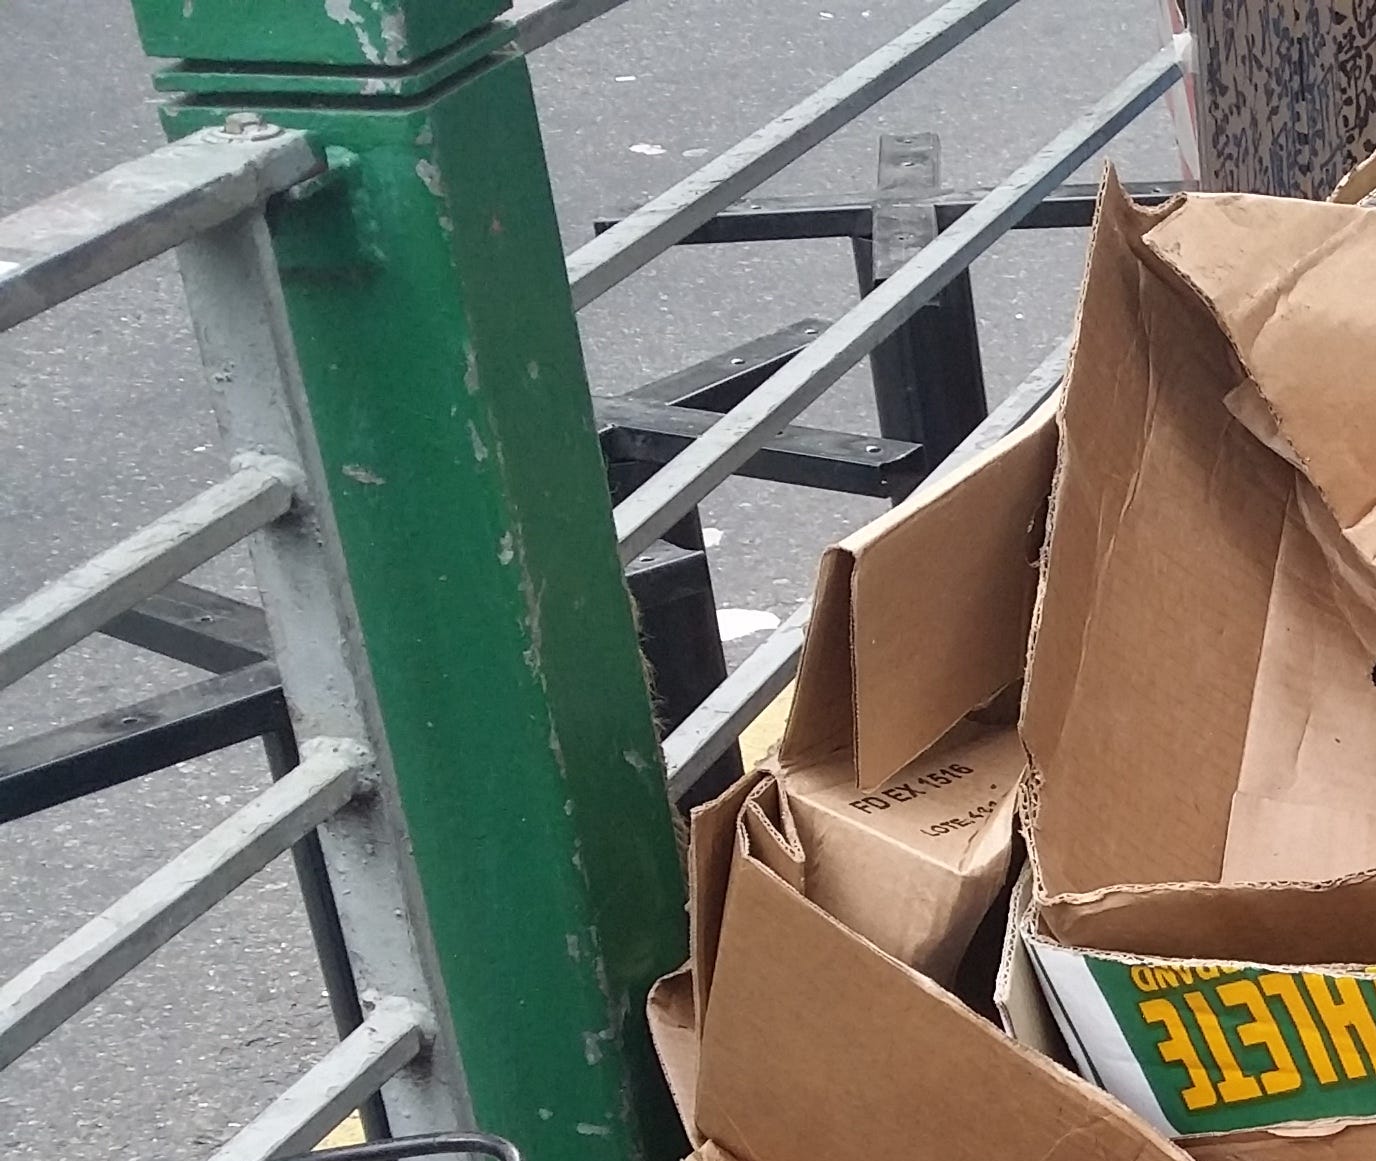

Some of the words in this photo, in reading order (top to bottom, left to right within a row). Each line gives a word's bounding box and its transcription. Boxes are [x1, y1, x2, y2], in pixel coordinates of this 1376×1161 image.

[848, 797, 890, 815] FD
[882, 783, 927, 804] EX
[918, 763, 975, 789] 1516
